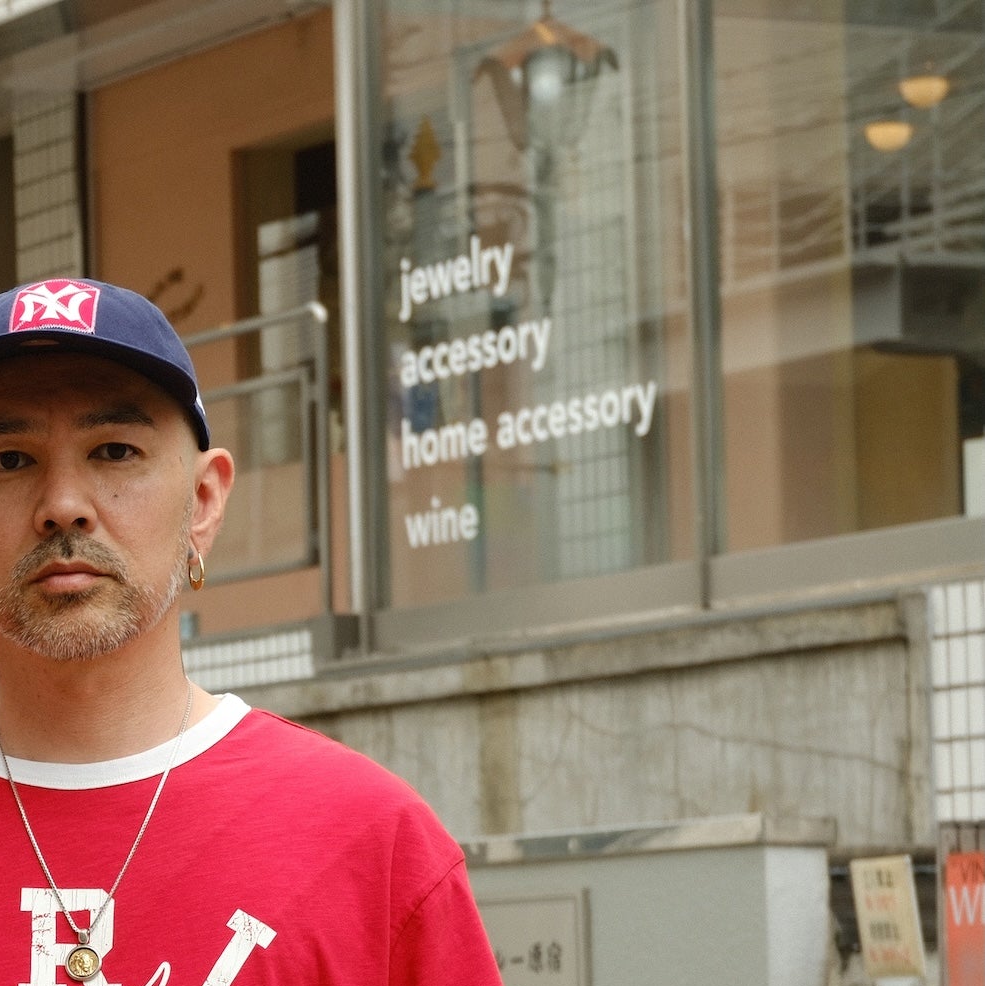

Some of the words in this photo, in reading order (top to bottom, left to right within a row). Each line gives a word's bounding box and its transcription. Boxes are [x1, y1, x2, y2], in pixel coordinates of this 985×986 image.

[399, 235, 514, 322] jewelry
[400, 317, 551, 387] accessory
[401, 418, 489, 470] home
[496, 382, 657, 450] accessory
[405, 497, 480, 548] wine
